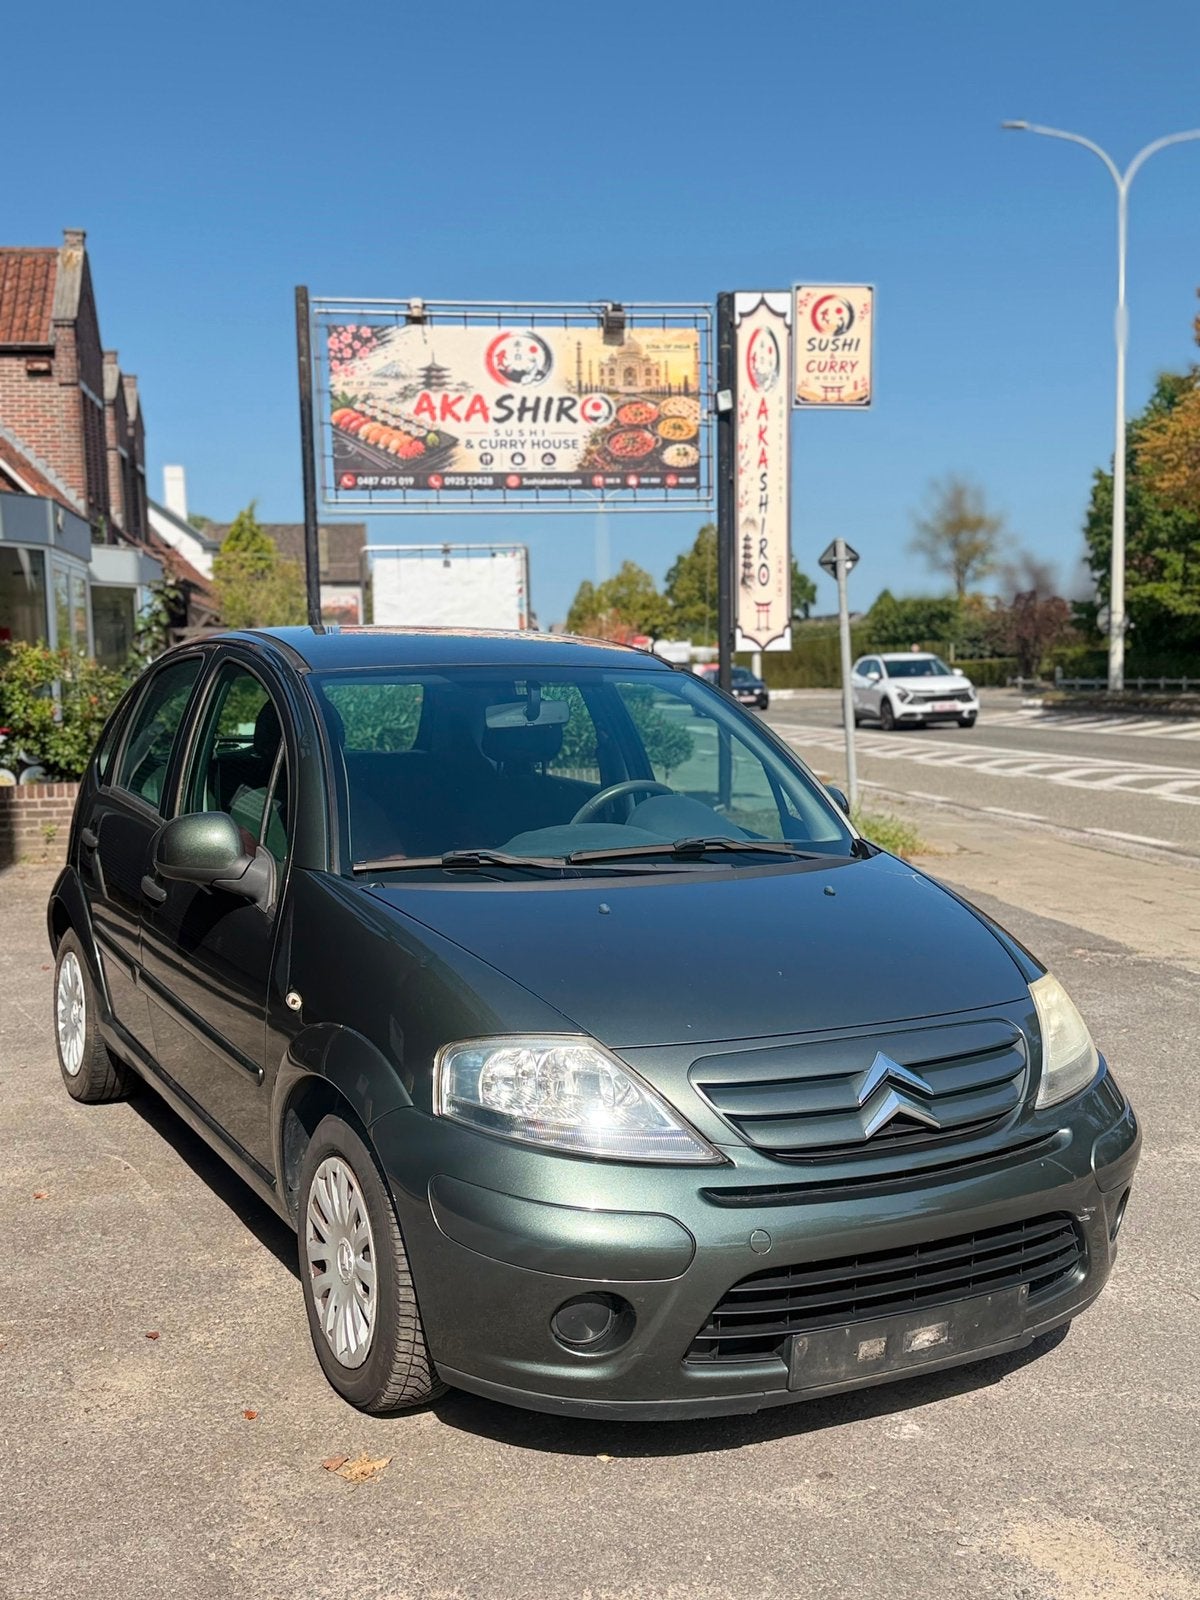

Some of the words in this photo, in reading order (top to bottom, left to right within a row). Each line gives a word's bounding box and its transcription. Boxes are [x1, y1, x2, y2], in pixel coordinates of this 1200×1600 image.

[806, 337, 861, 352] SUSHI
[805, 360, 860, 373] CURRY
[413, 391, 614, 424] AKASHIRO
[494, 429, 546, 437] SUSHI
[464, 439, 474, 449] &
[478, 439, 527, 450] CURRY
[531, 439, 579, 449] HOUSE
[357, 476, 379, 486] 0487
[381, 476, 397, 486] 475
[399, 476, 415, 486] 019
[756, 397, 769, 587] AKASHIRO
